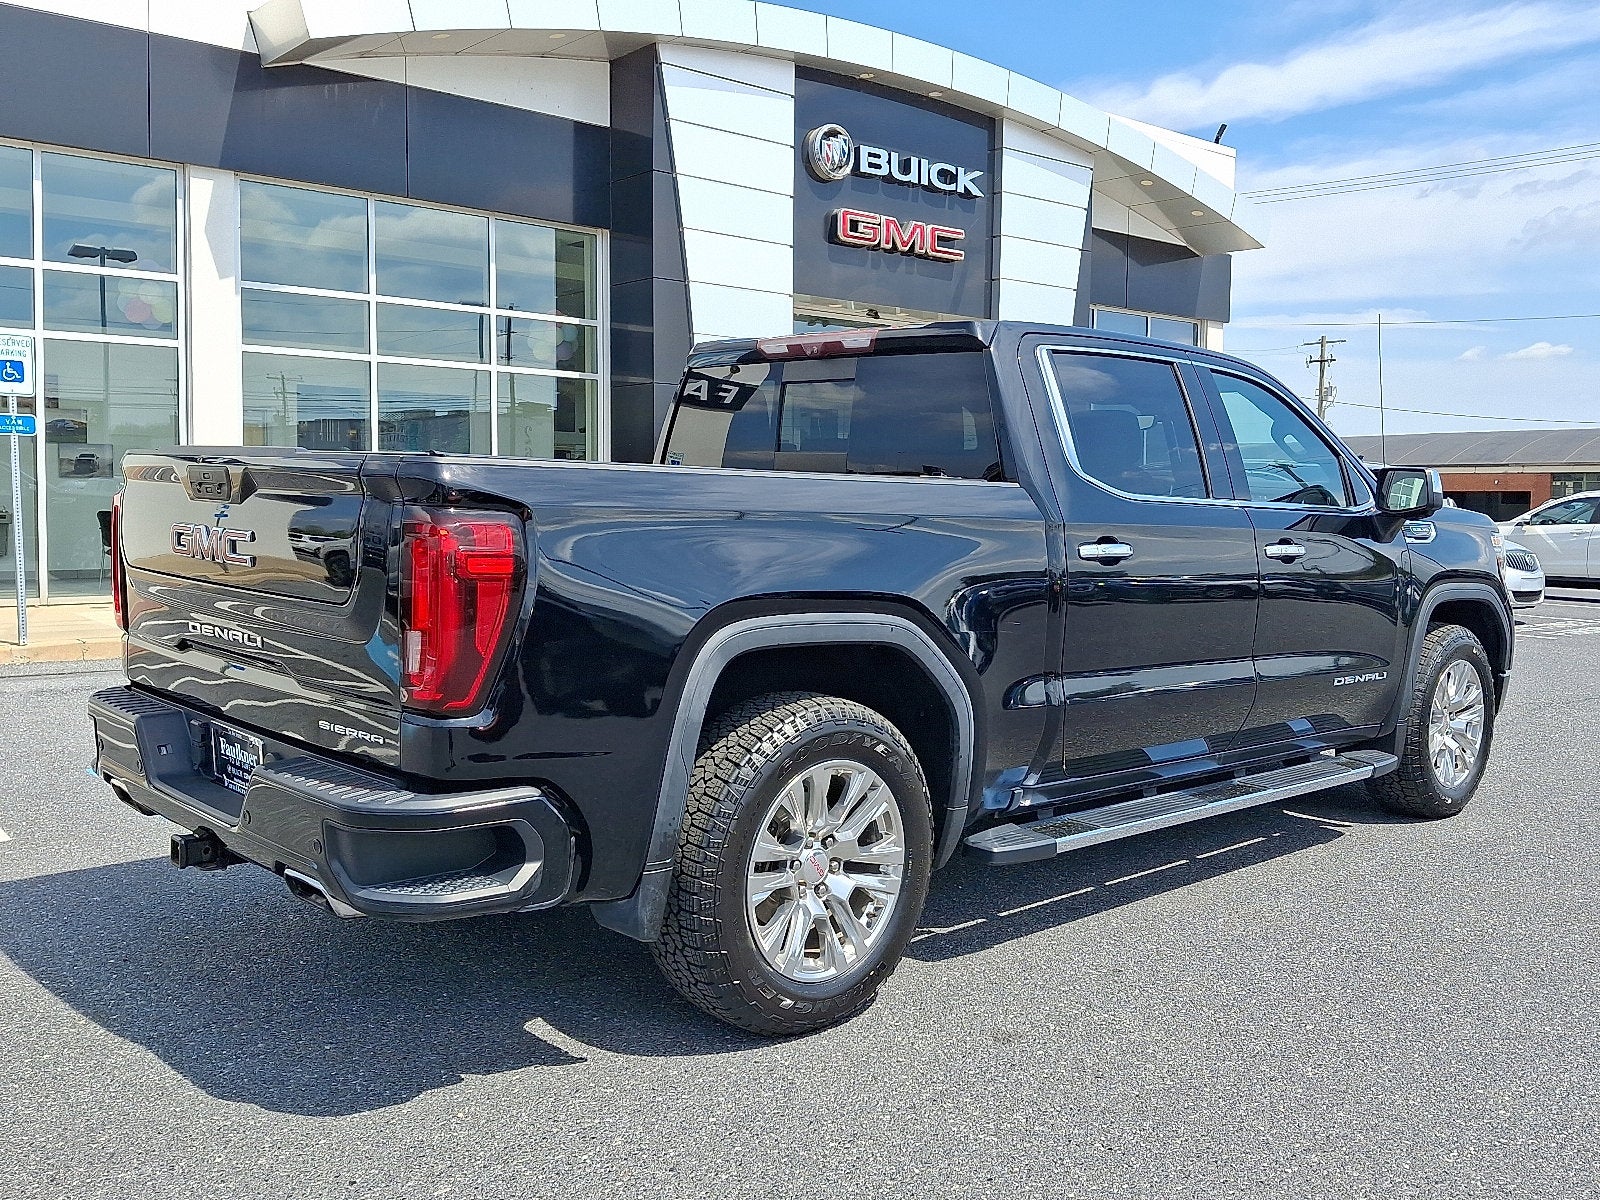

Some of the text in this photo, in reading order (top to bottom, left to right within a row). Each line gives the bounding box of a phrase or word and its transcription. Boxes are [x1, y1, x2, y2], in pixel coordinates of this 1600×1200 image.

[859, 143, 985, 198] BUICK
[836, 207, 966, 261] GMC
[170, 522, 256, 567] GMC
[188, 621, 263, 648] DENALI
[1333, 671, 1388, 687] DENALI
[318, 720, 384, 744] SIERRA
[219, 736, 258, 768] Faulkner
[809, 855, 825, 877] GMC
